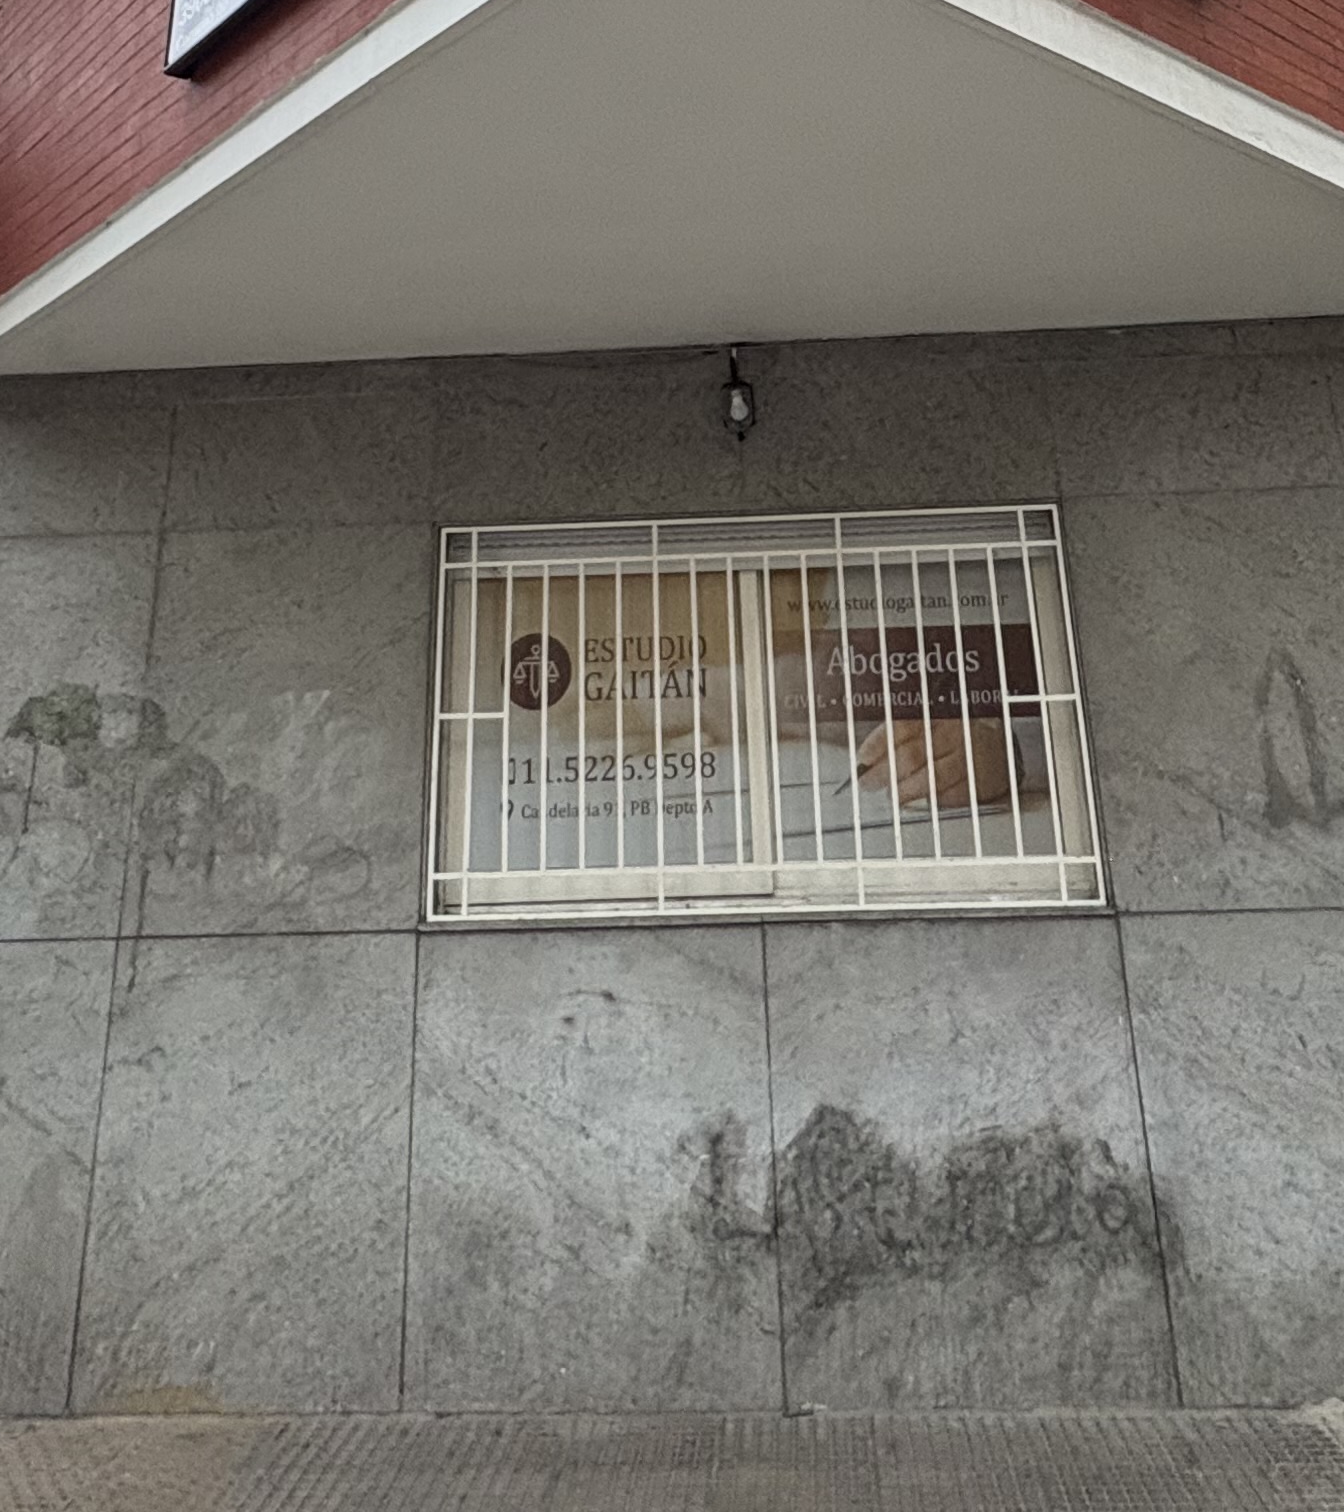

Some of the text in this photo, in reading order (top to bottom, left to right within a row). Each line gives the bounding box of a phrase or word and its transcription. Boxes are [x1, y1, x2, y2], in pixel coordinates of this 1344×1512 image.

[786, 593, 1009, 614] www.studogatan.om.r
[584, 634, 707, 663] ESTUDIO
[826, 643, 980, 682] Abogados
[584, 661, 707, 701] GAITÁN
[784, 688, 1020, 708] CIVL OMERCIA LBOR
[521, 802, 600, 819] Cadelaia
[603, 801, 626, 819] 9,
[630, 800, 651, 817] PB
